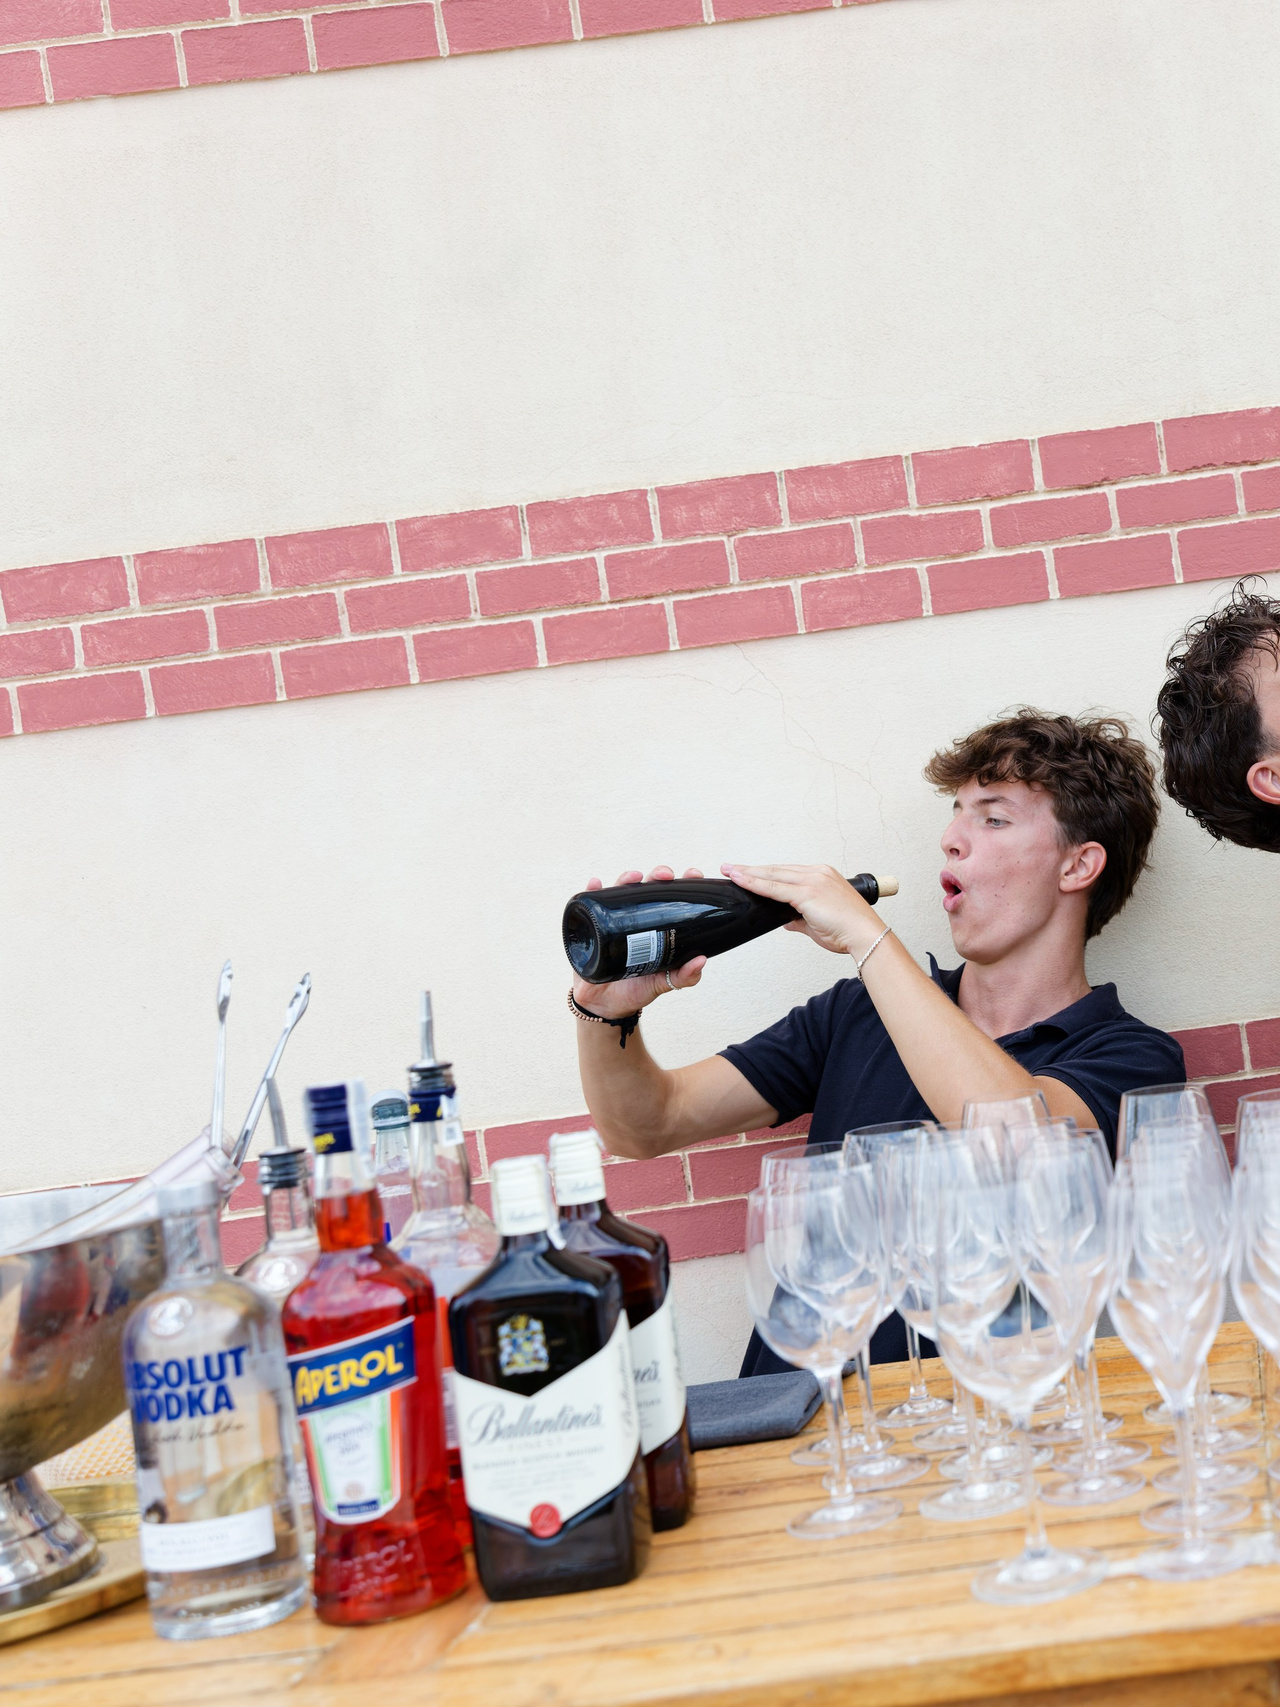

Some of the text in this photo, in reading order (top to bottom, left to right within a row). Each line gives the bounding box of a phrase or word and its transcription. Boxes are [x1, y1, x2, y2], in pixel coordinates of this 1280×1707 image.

[127, 1344, 248, 1391] BSOLUT
[295, 1344, 404, 1407] APEROL
[467, 1401, 604, 1446] Ballantine's
